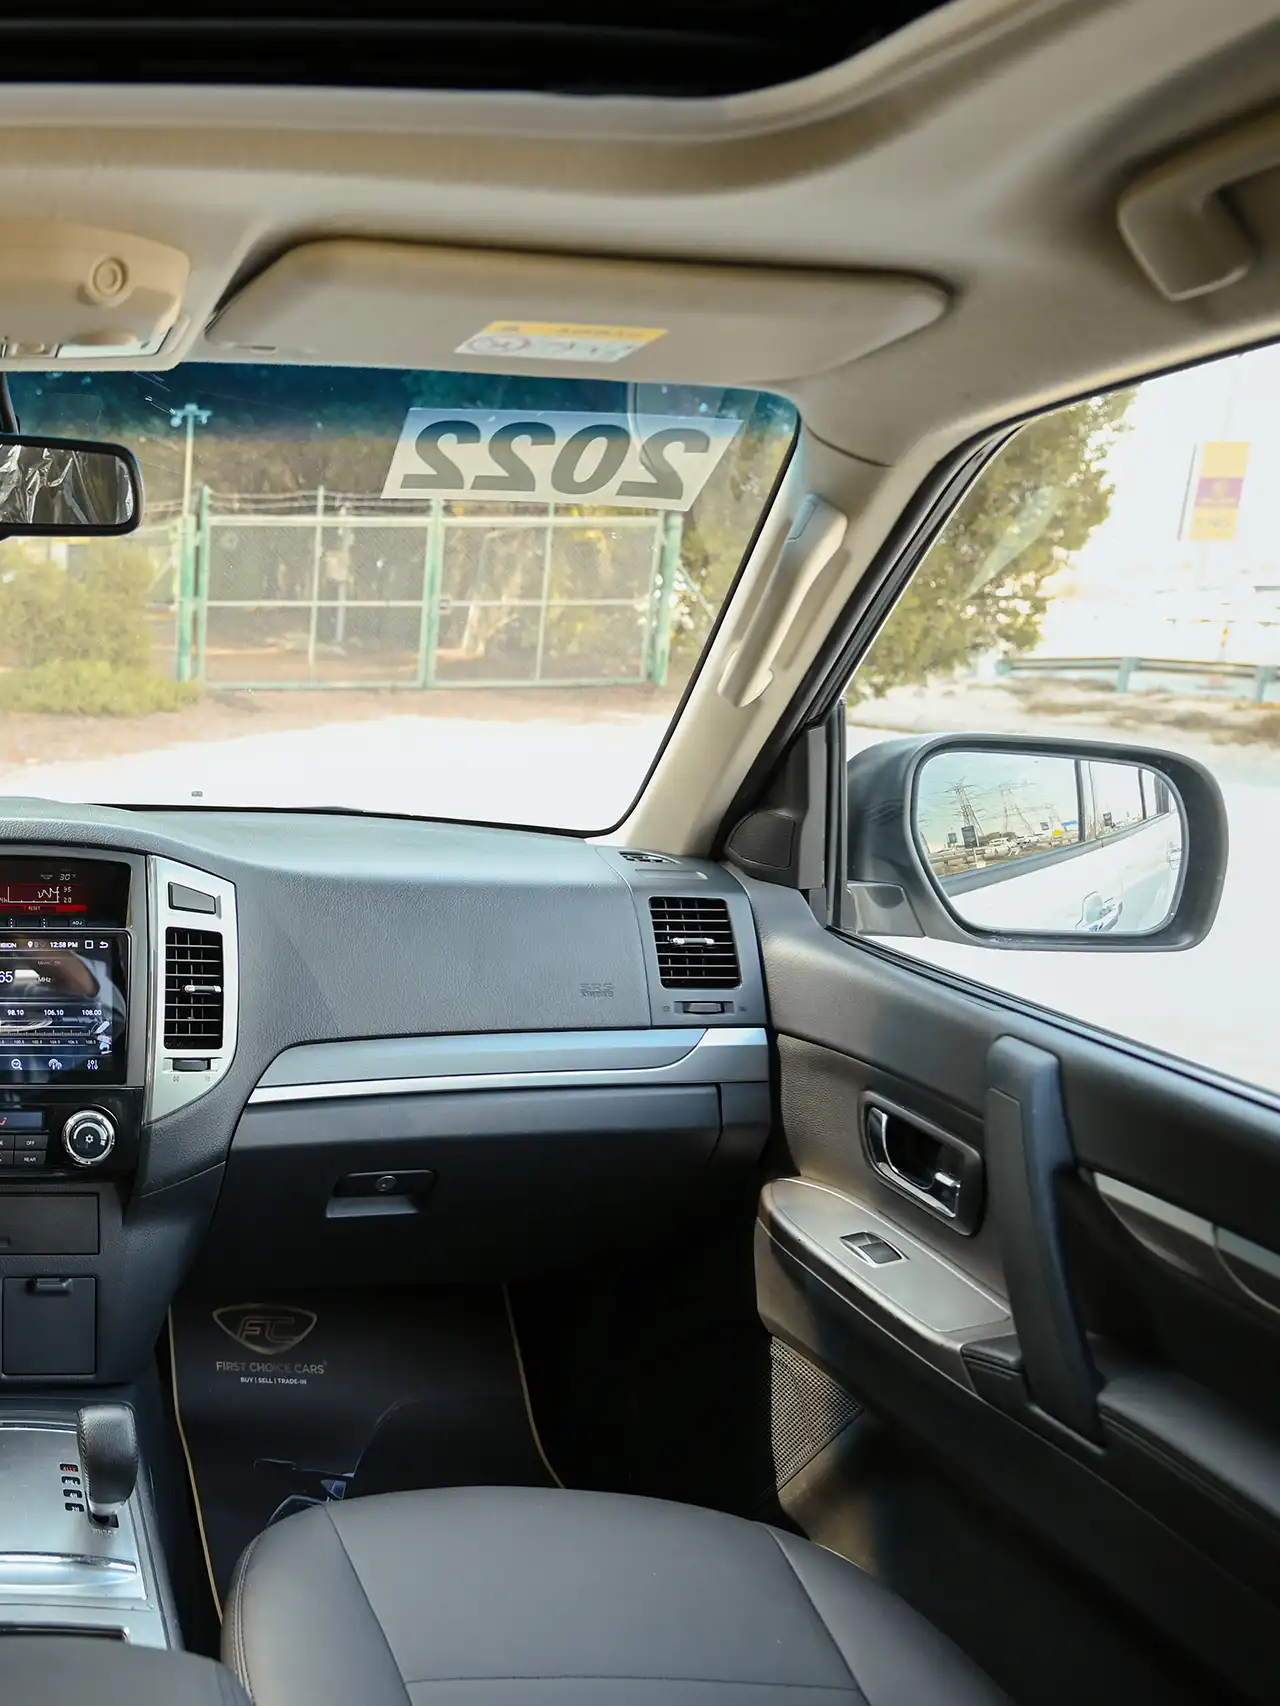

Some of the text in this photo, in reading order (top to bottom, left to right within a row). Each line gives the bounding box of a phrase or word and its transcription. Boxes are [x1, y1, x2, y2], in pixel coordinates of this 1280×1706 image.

[59, 873, 71, 881] 30
[63, 896, 72, 904] 20
[215, 1360, 325, 1375] FIRST CHOICE CARS
